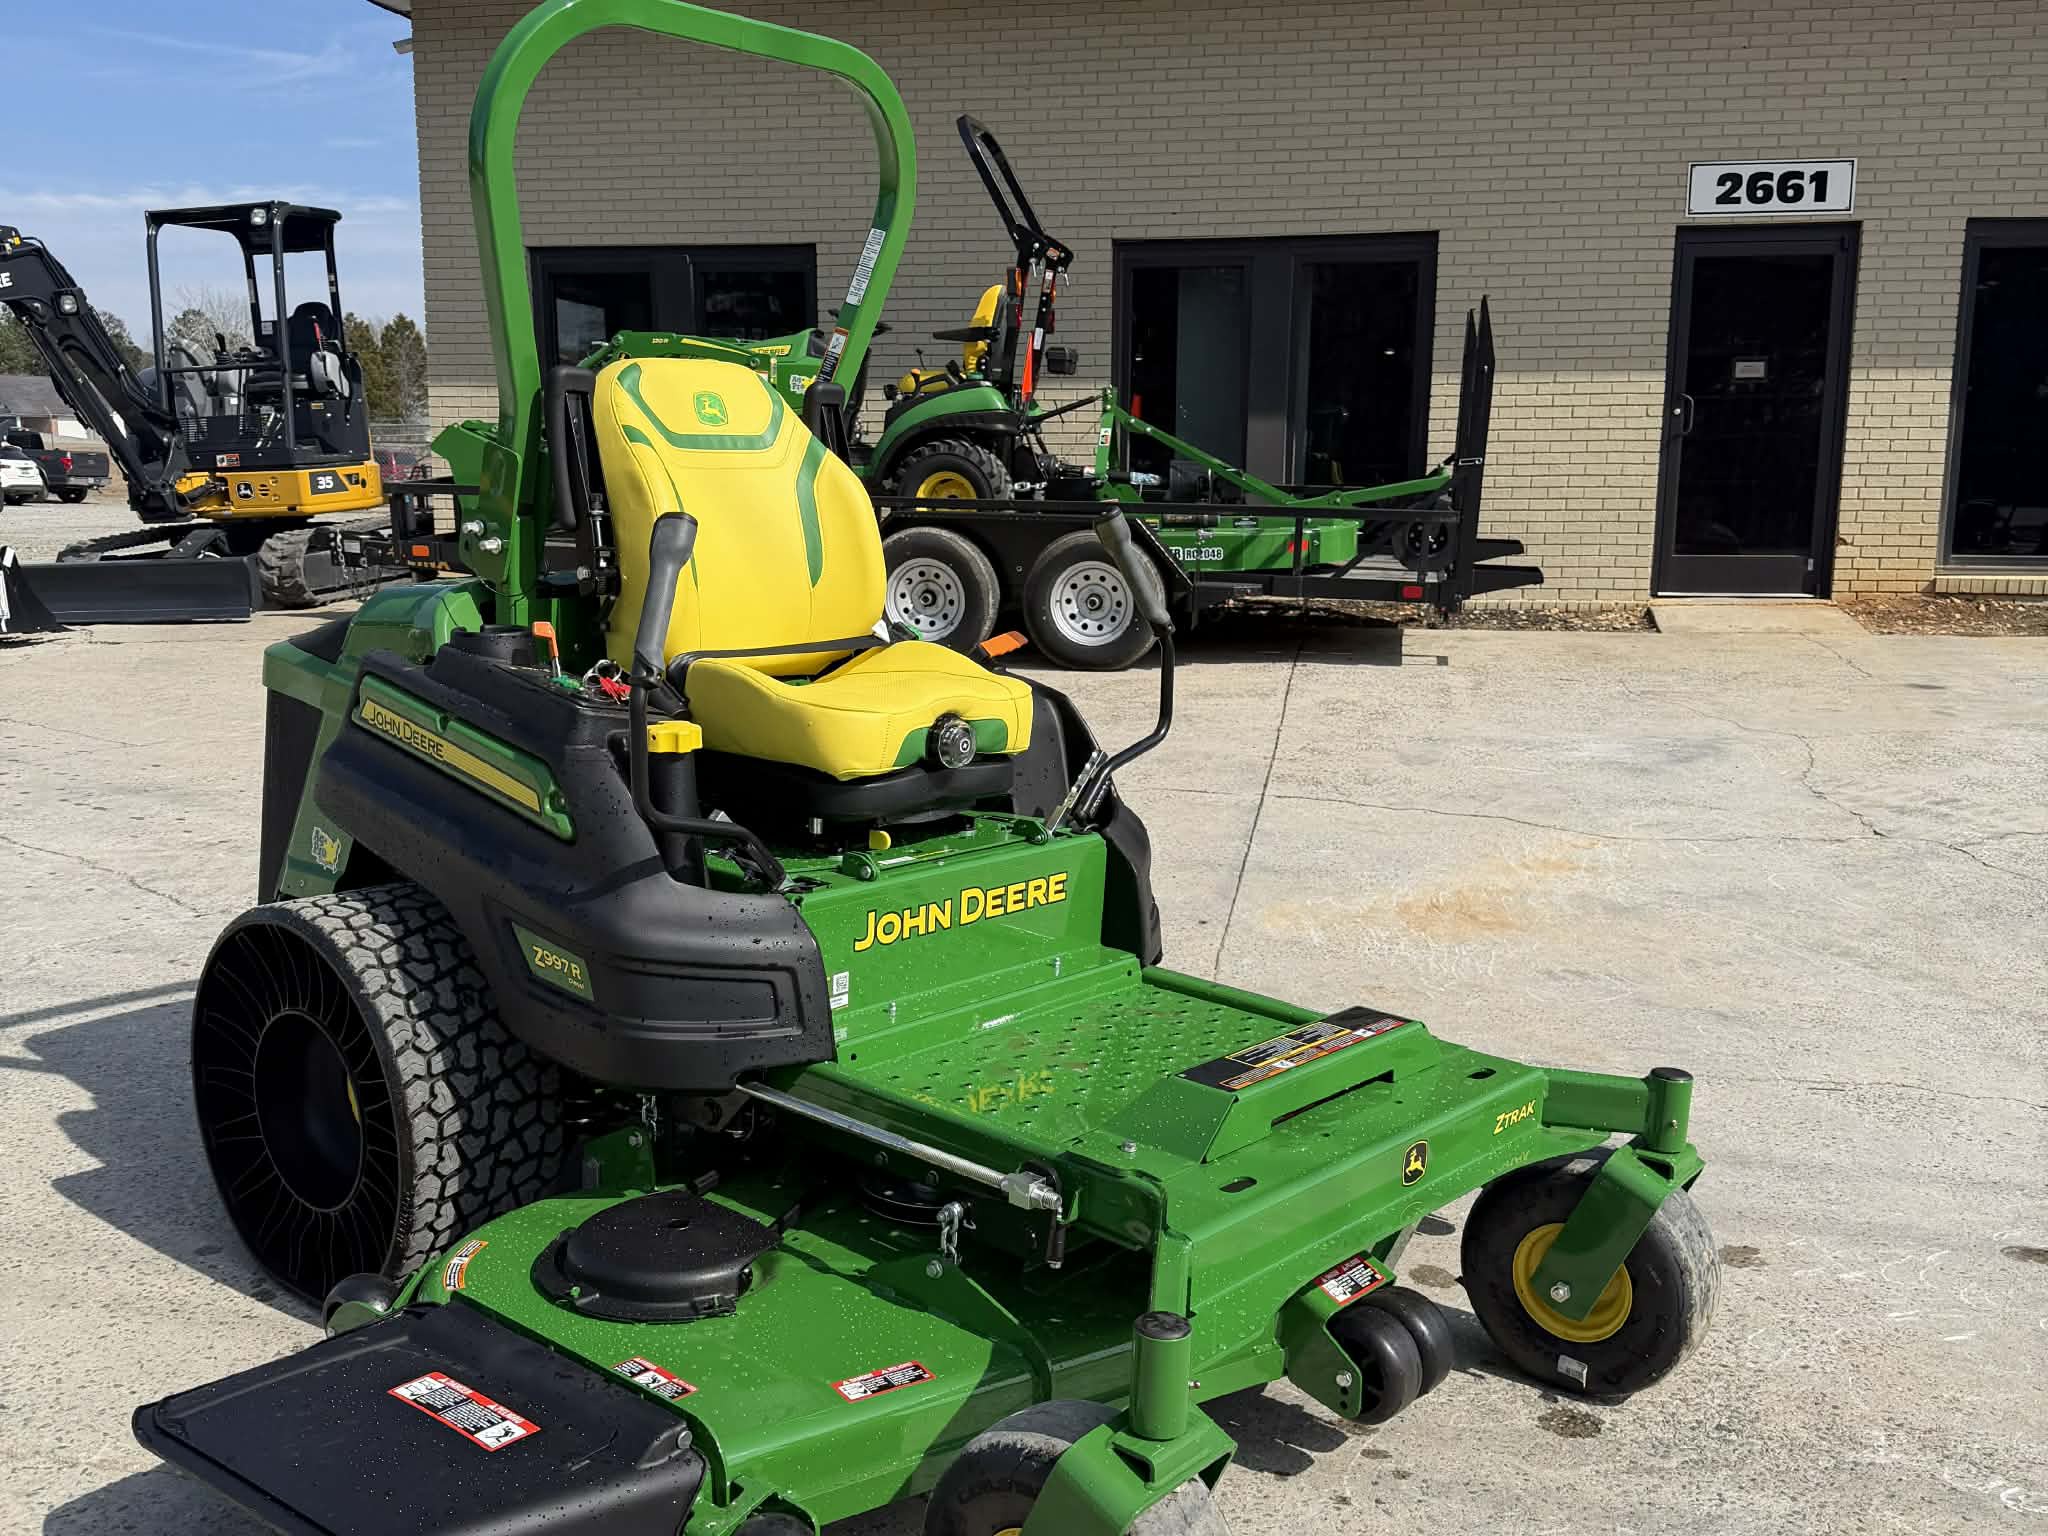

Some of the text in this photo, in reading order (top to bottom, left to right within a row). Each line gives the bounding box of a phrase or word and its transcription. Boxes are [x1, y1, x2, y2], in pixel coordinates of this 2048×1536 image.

[1715, 170, 1829, 205] 2661
[316, 475, 334, 490] 35
[368, 705, 445, 760] JOHN DEERE
[854, 872, 1068, 952] JOHN DEERE
[1493, 1099, 1537, 1136] ZTRAK
